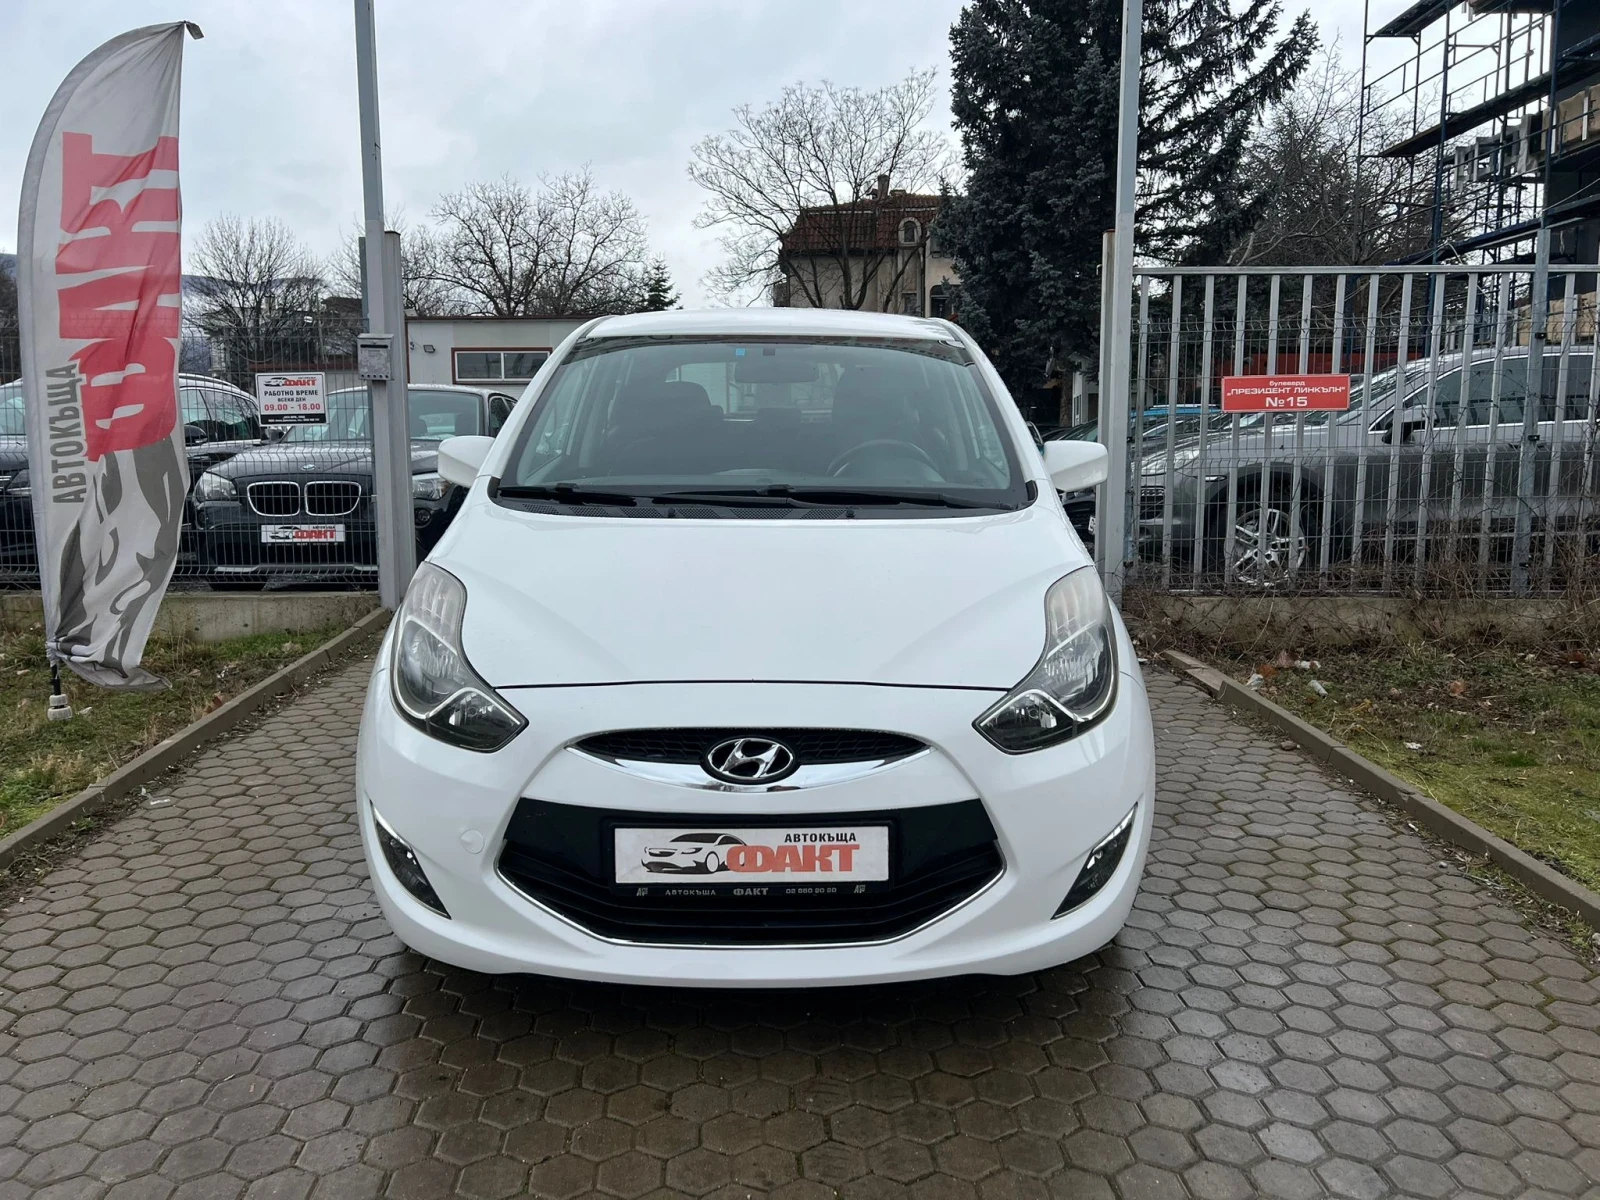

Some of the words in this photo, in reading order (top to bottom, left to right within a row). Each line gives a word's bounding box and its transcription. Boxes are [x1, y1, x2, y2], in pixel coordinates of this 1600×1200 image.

[55, 131, 180, 462] ФАКТ
[264, 403, 288, 411] 09.00
[45, 361, 88, 504] АВТОКЪЩА
[784, 832, 857, 843] АВТОКЪЩА
[727, 844, 860, 873] ФАКТ
[733, 887, 769, 896] ФАКТ
